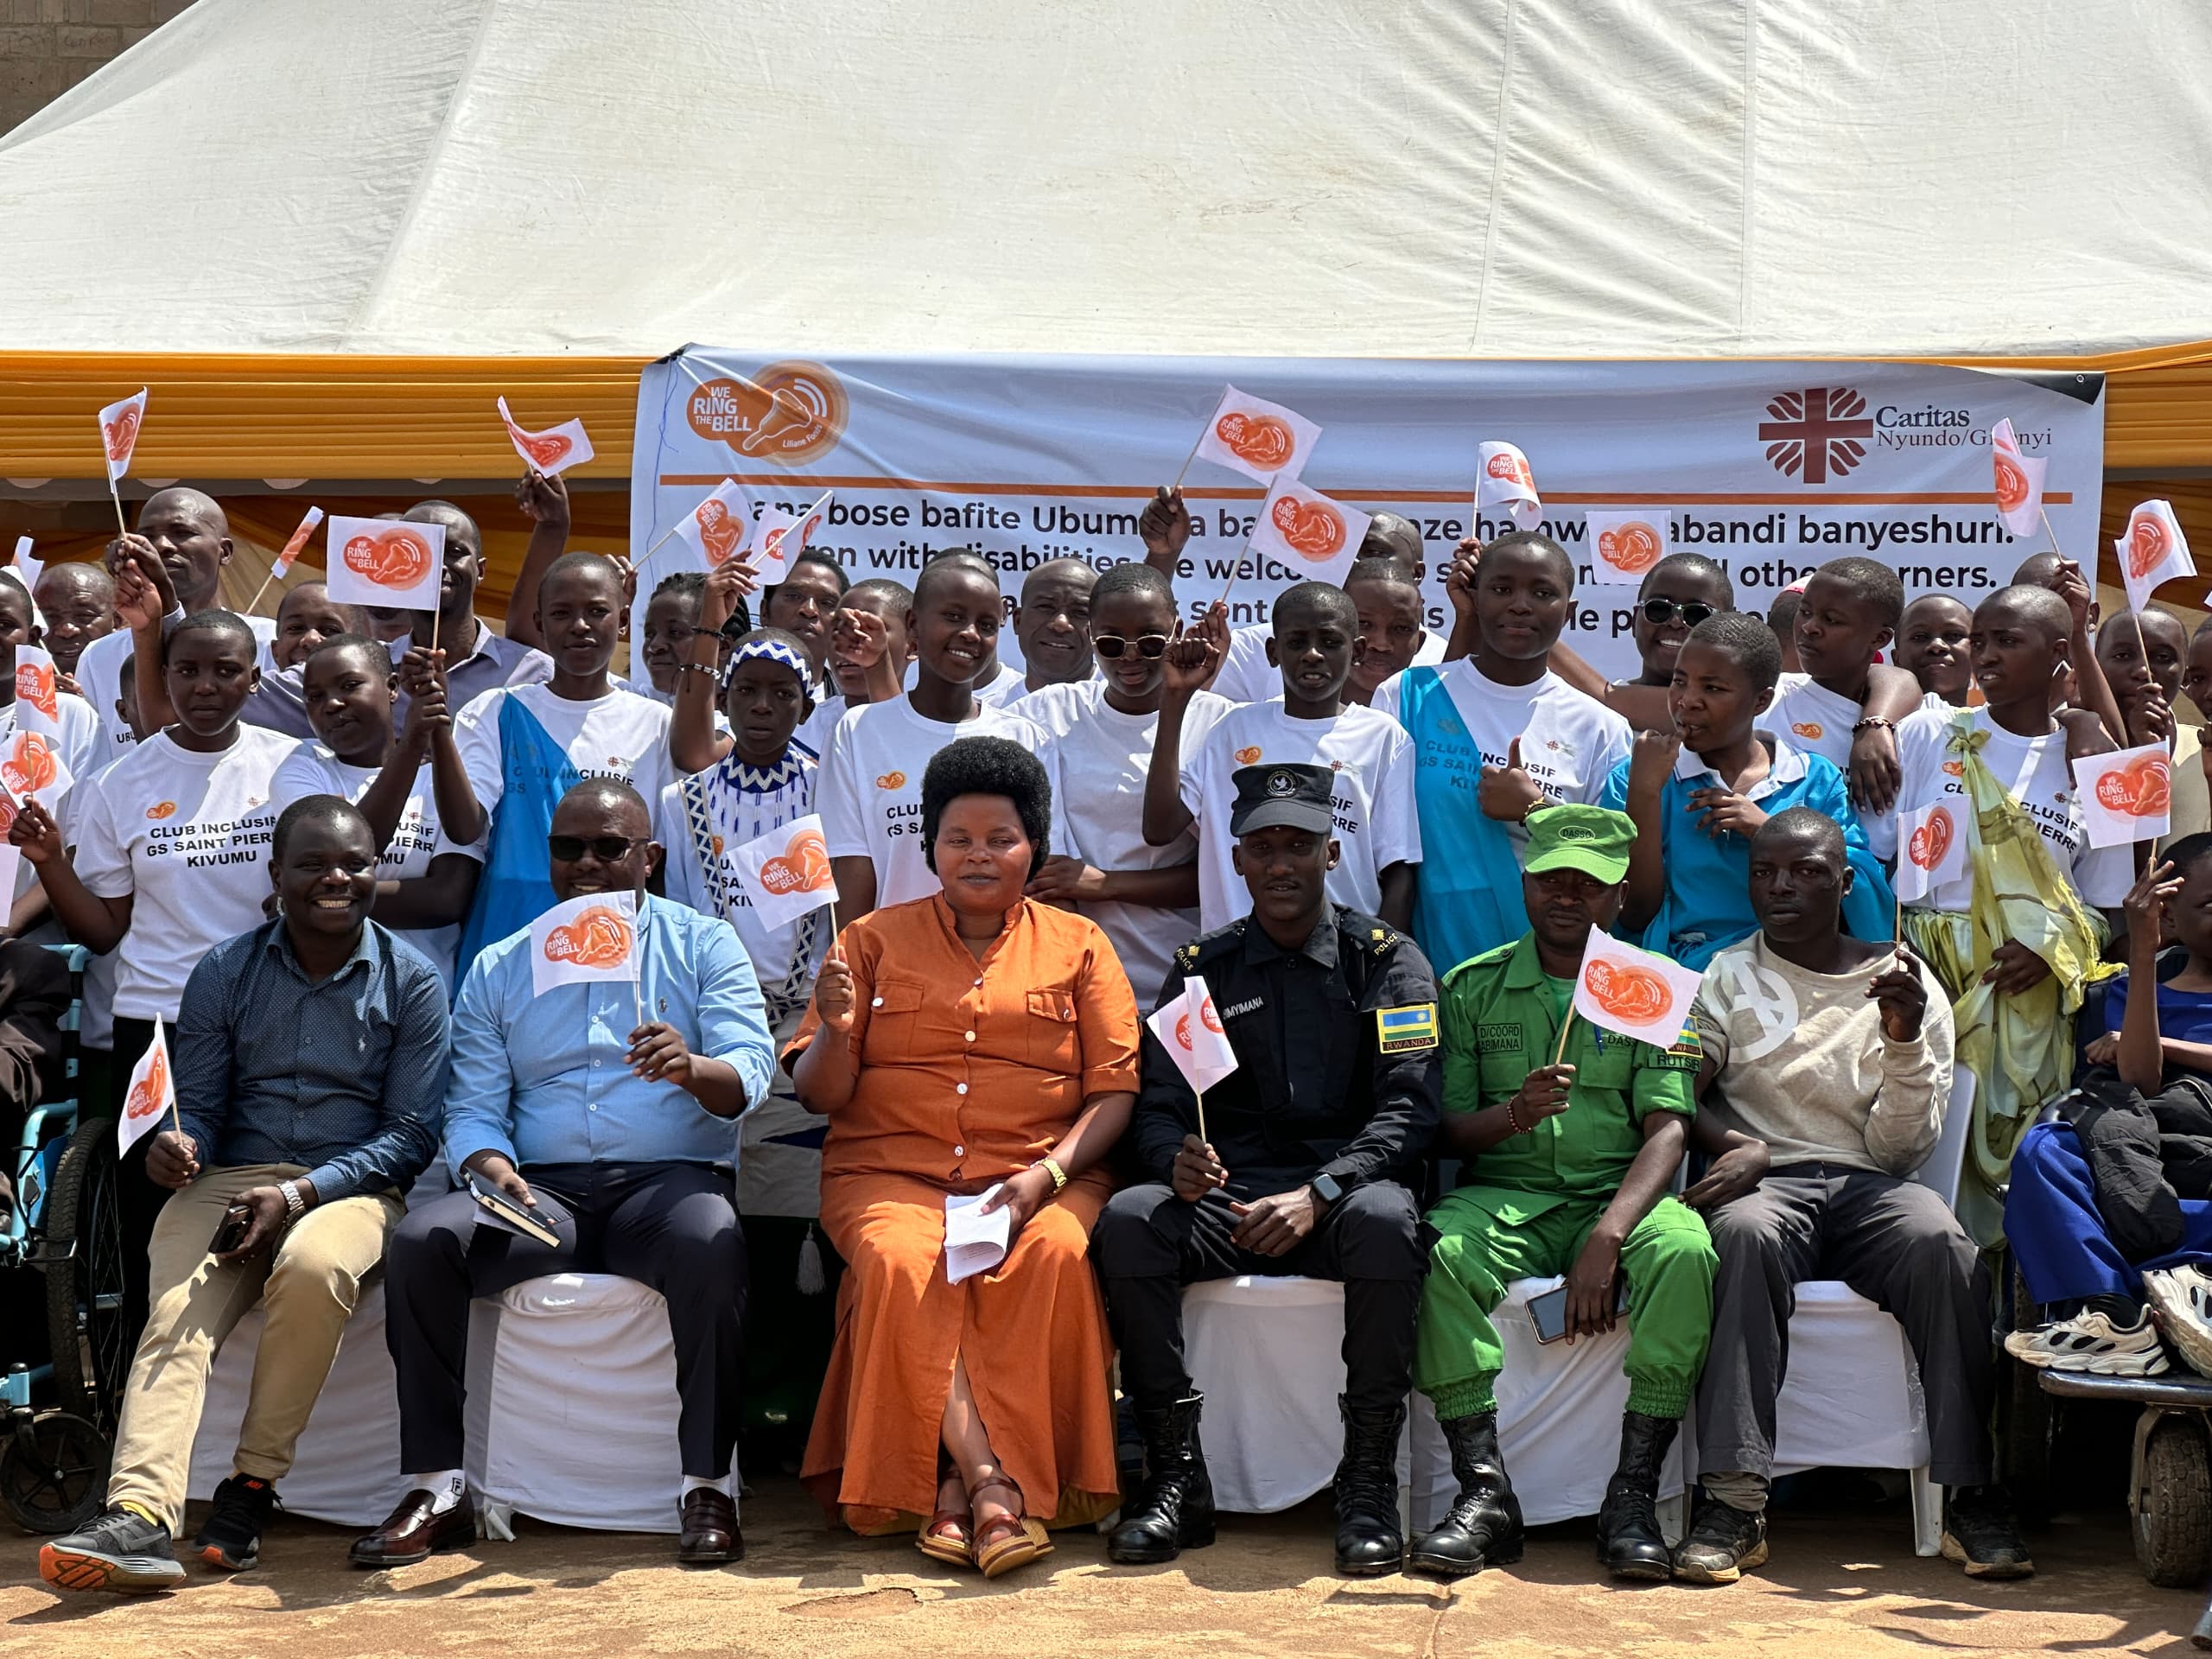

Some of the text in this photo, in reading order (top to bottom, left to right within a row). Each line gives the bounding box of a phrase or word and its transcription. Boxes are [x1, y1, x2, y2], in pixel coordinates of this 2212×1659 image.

[710, 386, 730, 398] WE
[693, 397, 738, 415] RING
[695, 415, 753, 432] THE BELL
[1875, 404, 1970, 429] Caritas
[1221, 418, 1244, 434] RING
[782, 438, 807, 448] Liliane
[1225, 430, 1246, 444] BELL
[1877, 429, 2052, 450] Nyundo/Gnyi
[1275, 502, 1296, 520] RING
[702, 515, 717, 533] BELL
[829, 496, 910, 527] bose
[921, 499, 1021, 531] bafite
[1033, 505, 1206, 537] Ubuma
[1798, 513, 2015, 551] banyeshuri.
[1280, 517, 1298, 534] BELL
[347, 546, 372, 558] RING
[357, 559, 380, 569] BELL
[16, 673, 39, 687] RING
[23, 685, 44, 698] BELL
[1478, 750, 1556, 778] INCUSIF
[2099, 783, 2123, 798] RING
[2113, 792, 2137, 805] BELL
[887, 804, 925, 819] CLU
[150, 825, 196, 839] CLUB
[1562, 829, 1592, 838] DASSO
[146, 831, 276, 857] GS SAINT PIER
[187, 850, 257, 868] KIVUMU
[763, 865, 789, 885] RING
[779, 871, 804, 889] BELL
[547, 934, 569, 952] RING
[556, 943, 582, 957] BELL
[1374, 932, 1398, 956] POLICE
[1587, 964, 1611, 986] RING
[1592, 982, 1614, 1000] BELL
[1480, 1025, 1520, 1039] D/COORD
[1386, 1038, 1432, 1051] RWANDA
